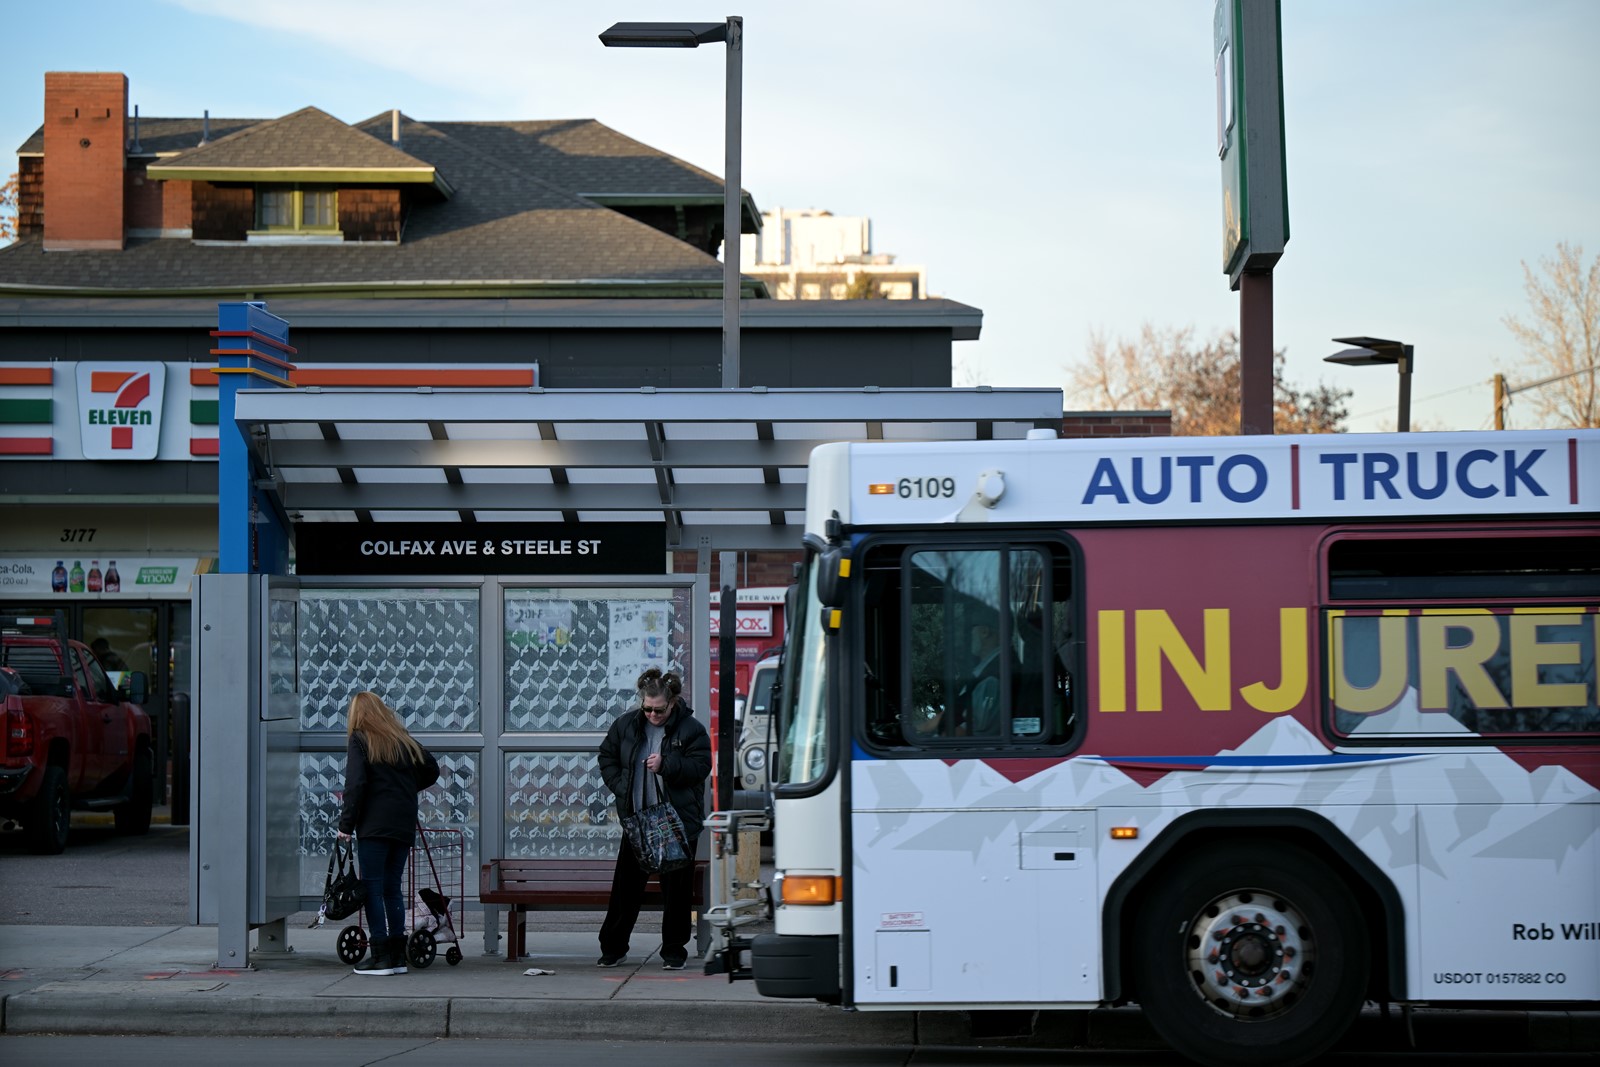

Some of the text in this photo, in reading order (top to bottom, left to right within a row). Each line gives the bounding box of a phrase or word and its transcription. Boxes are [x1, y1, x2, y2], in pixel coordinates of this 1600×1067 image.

[1082, 448, 1548, 504] AUTO TRUCK
[898, 476, 956, 499] 6109
[60, 528, 97, 543] 3177
[360, 540, 601, 556] COLFAX AVE & STEELE ST
[1097, 606, 1600, 714] INJURE
[1513, 923, 1554, 940] Rob
[1433, 972, 1567, 984] USDOT 0157882 CO
